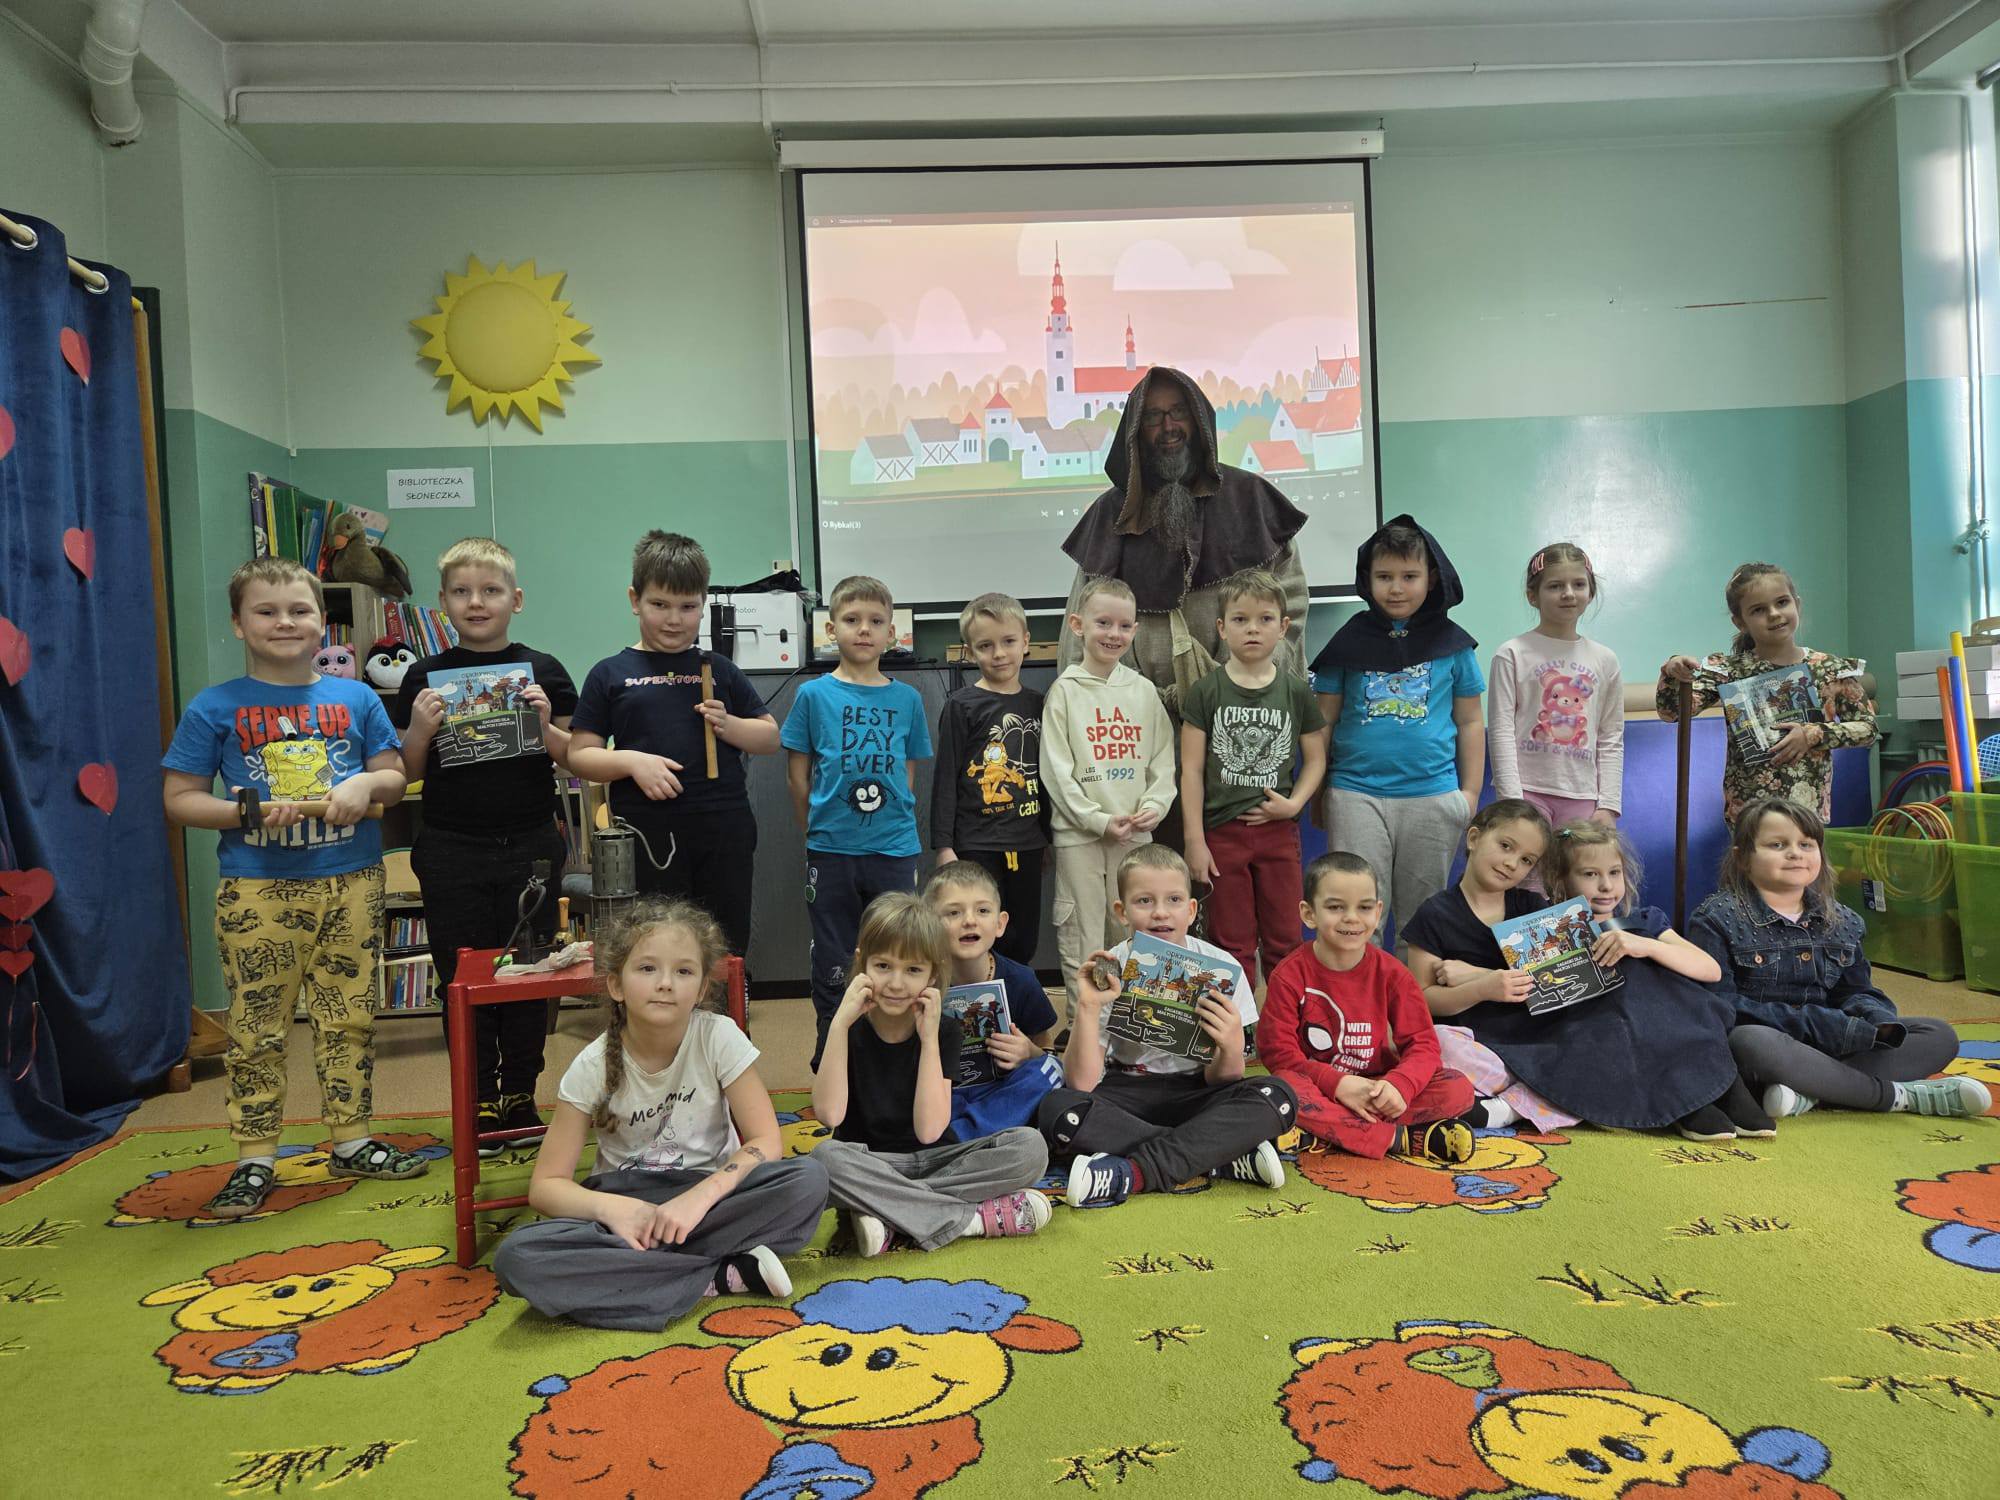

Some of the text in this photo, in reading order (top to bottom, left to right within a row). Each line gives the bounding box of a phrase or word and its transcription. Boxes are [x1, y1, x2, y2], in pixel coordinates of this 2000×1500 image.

[399, 478, 463, 486] BIBLIOTECZKA
[406, 492, 460, 500] SŁONECZKA
[316, 703, 351, 739] UP
[842, 705, 898, 727] BEST
[1095, 706, 1130, 723] L.A.
[1223, 705, 1282, 729] CUSTOM
[842, 727, 895, 752] DAY
[1086, 725, 1142, 742] SPORT
[1093, 743, 1141, 760] DEPT.
[841, 754, 895, 775] EVER
[1085, 766, 1135, 780] LOS 1992
[1081, 775, 1103, 783] ANGELES
[1221, 767, 1278, 788] MOTORCYCLES
[1347, 1022, 1371, 1033] WITH
[1344, 1036, 1373, 1046] GREAT
[1340, 1055, 1370, 1070] COMES
